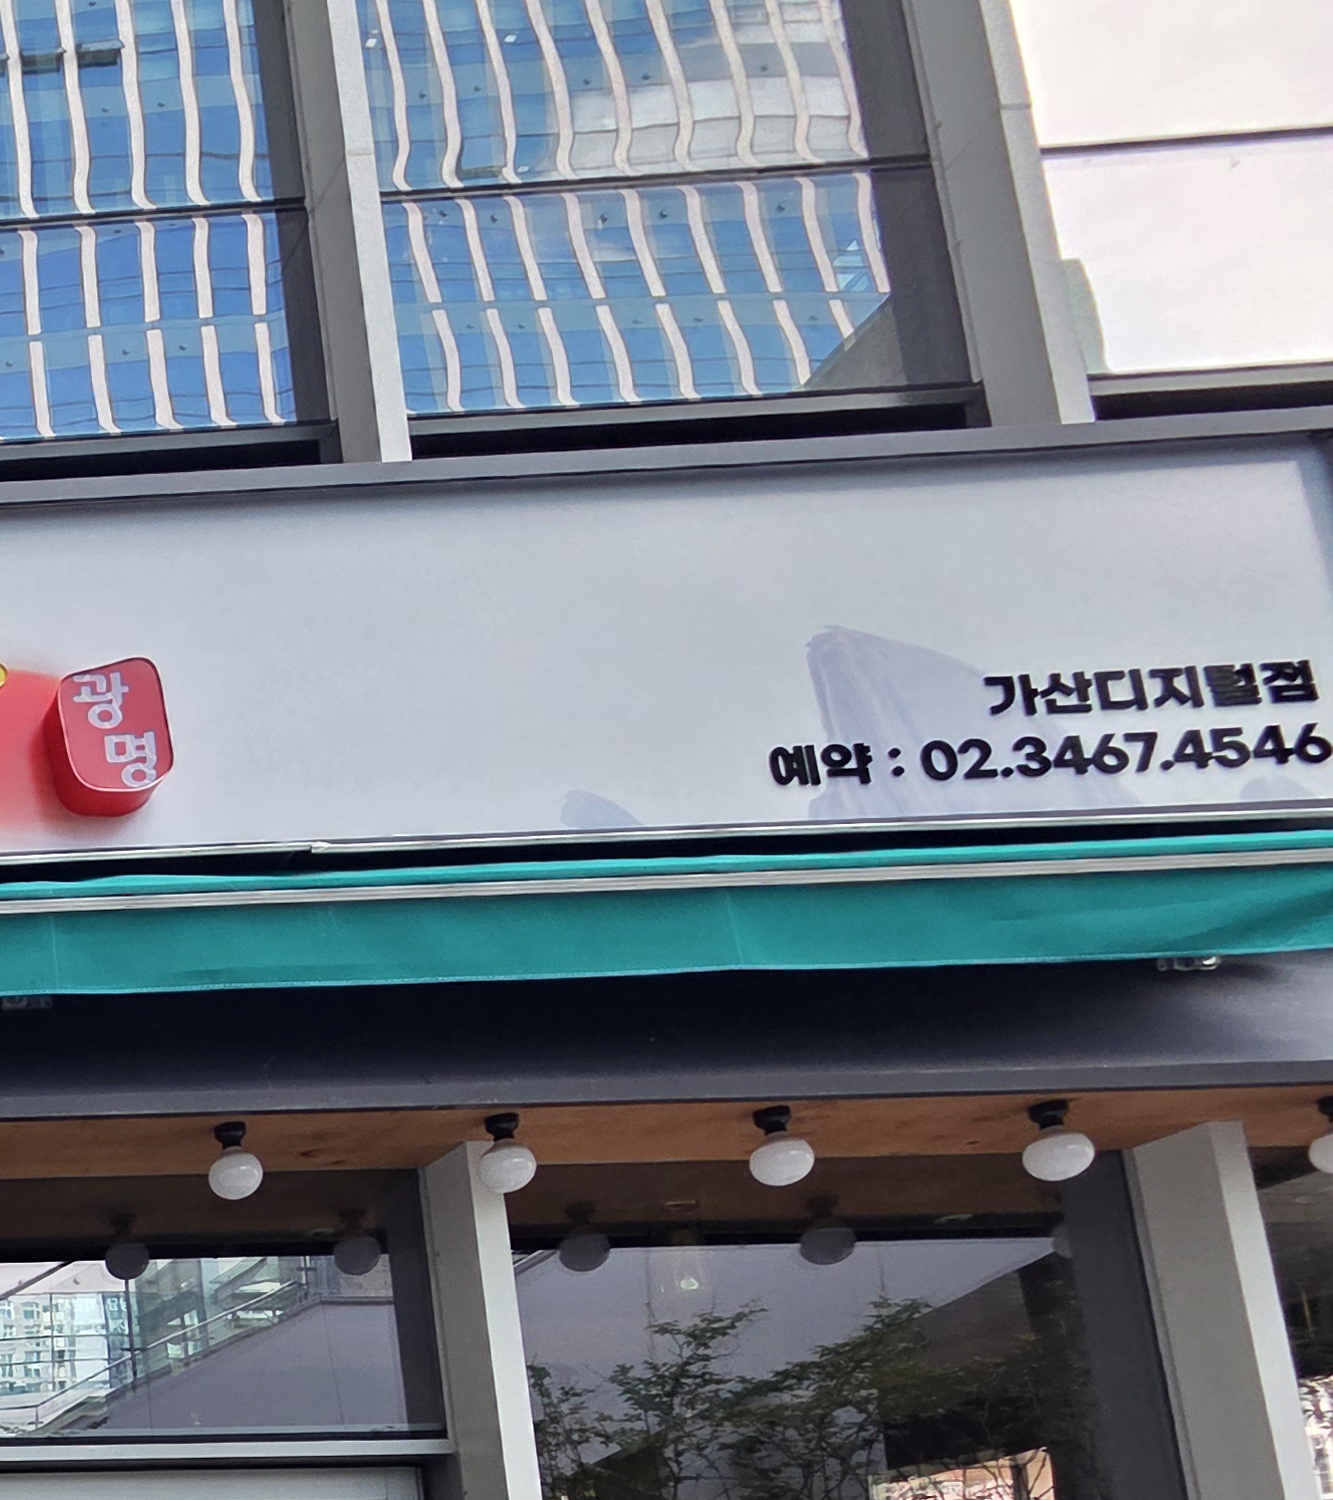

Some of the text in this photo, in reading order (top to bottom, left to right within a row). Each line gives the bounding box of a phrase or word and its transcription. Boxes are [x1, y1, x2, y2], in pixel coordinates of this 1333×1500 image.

[983, 658, 1320, 717] 가산디지털점
[72, 671, 158, 788] 광명
[920, 722, 1333, 782] 02.3467.4546
